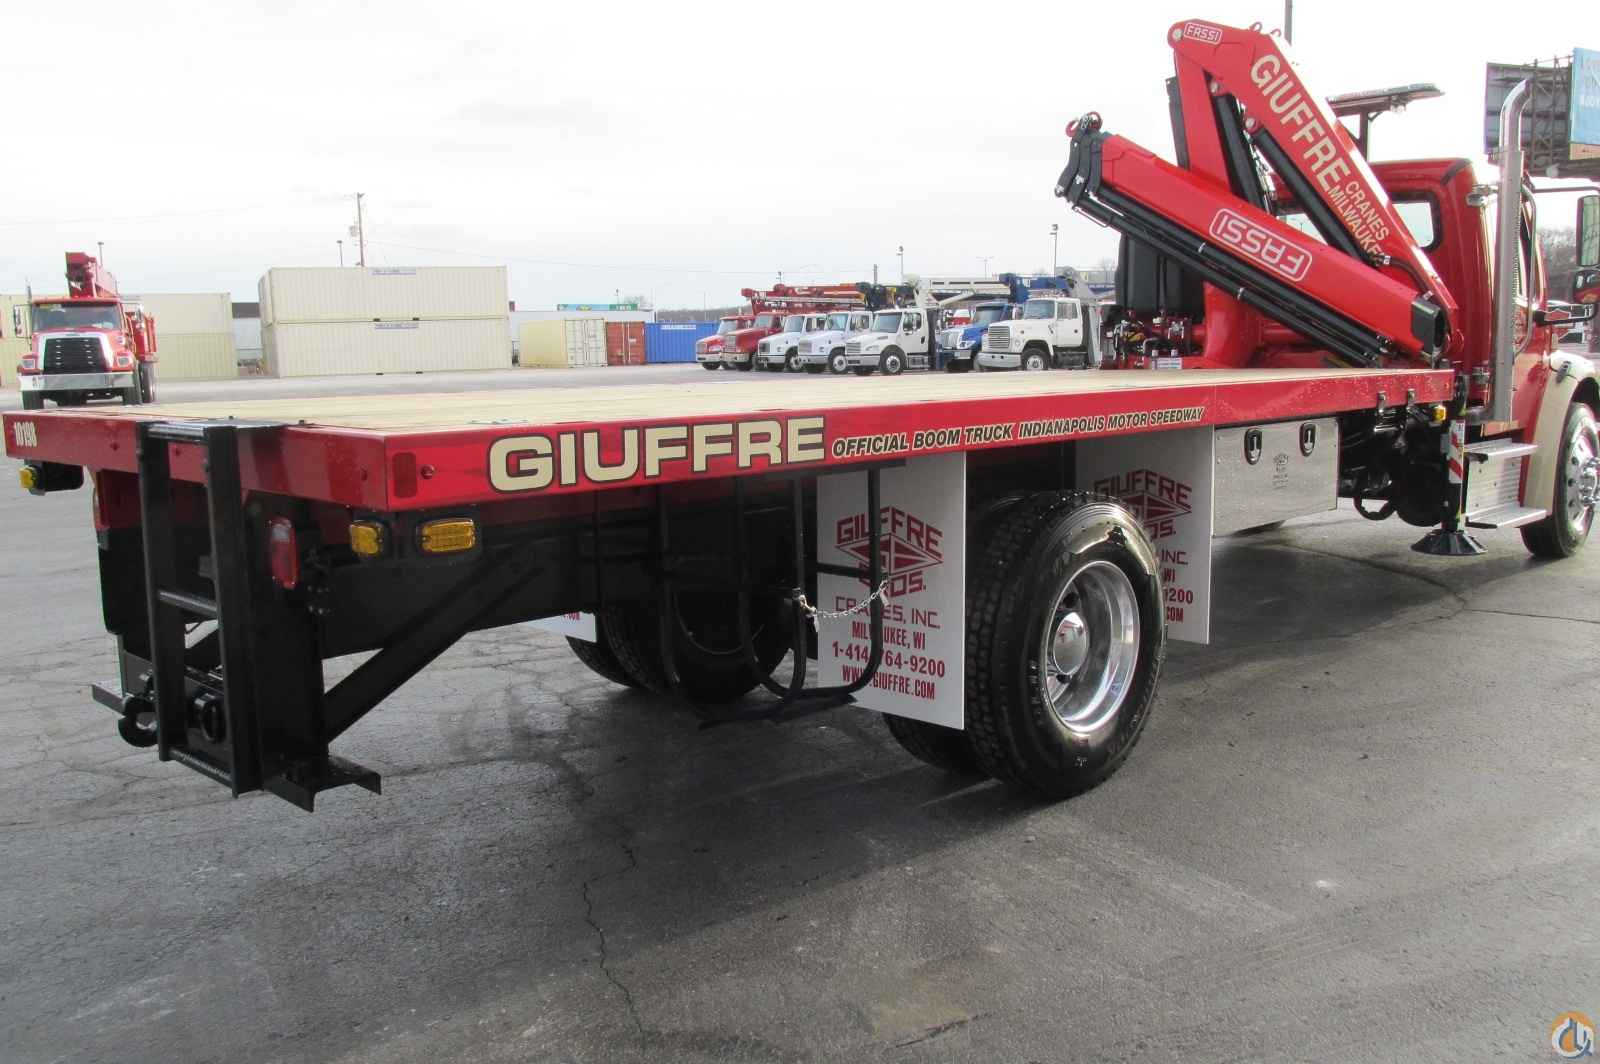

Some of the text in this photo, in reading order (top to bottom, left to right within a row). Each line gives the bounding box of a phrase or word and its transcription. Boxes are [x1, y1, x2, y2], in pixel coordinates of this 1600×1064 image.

[1186, 24, 1220, 42] FASSI
[1250, 54, 1350, 189] GIUFFRE
[1346, 181, 1390, 241] CRANES
[1217, 214, 1305, 275] FASSI
[488, 415, 826, 493] GIUFFRE
[831, 406, 1205, 459] OFFICIAL BOOM TRUCK INDIANAPOLIS MOTOR SPEEDWAY
[851, 621, 926, 650] MILUKEE, WI
[911, 607, 941, 629] INC.
[832, 640, 946, 679] 1-41464-9200
